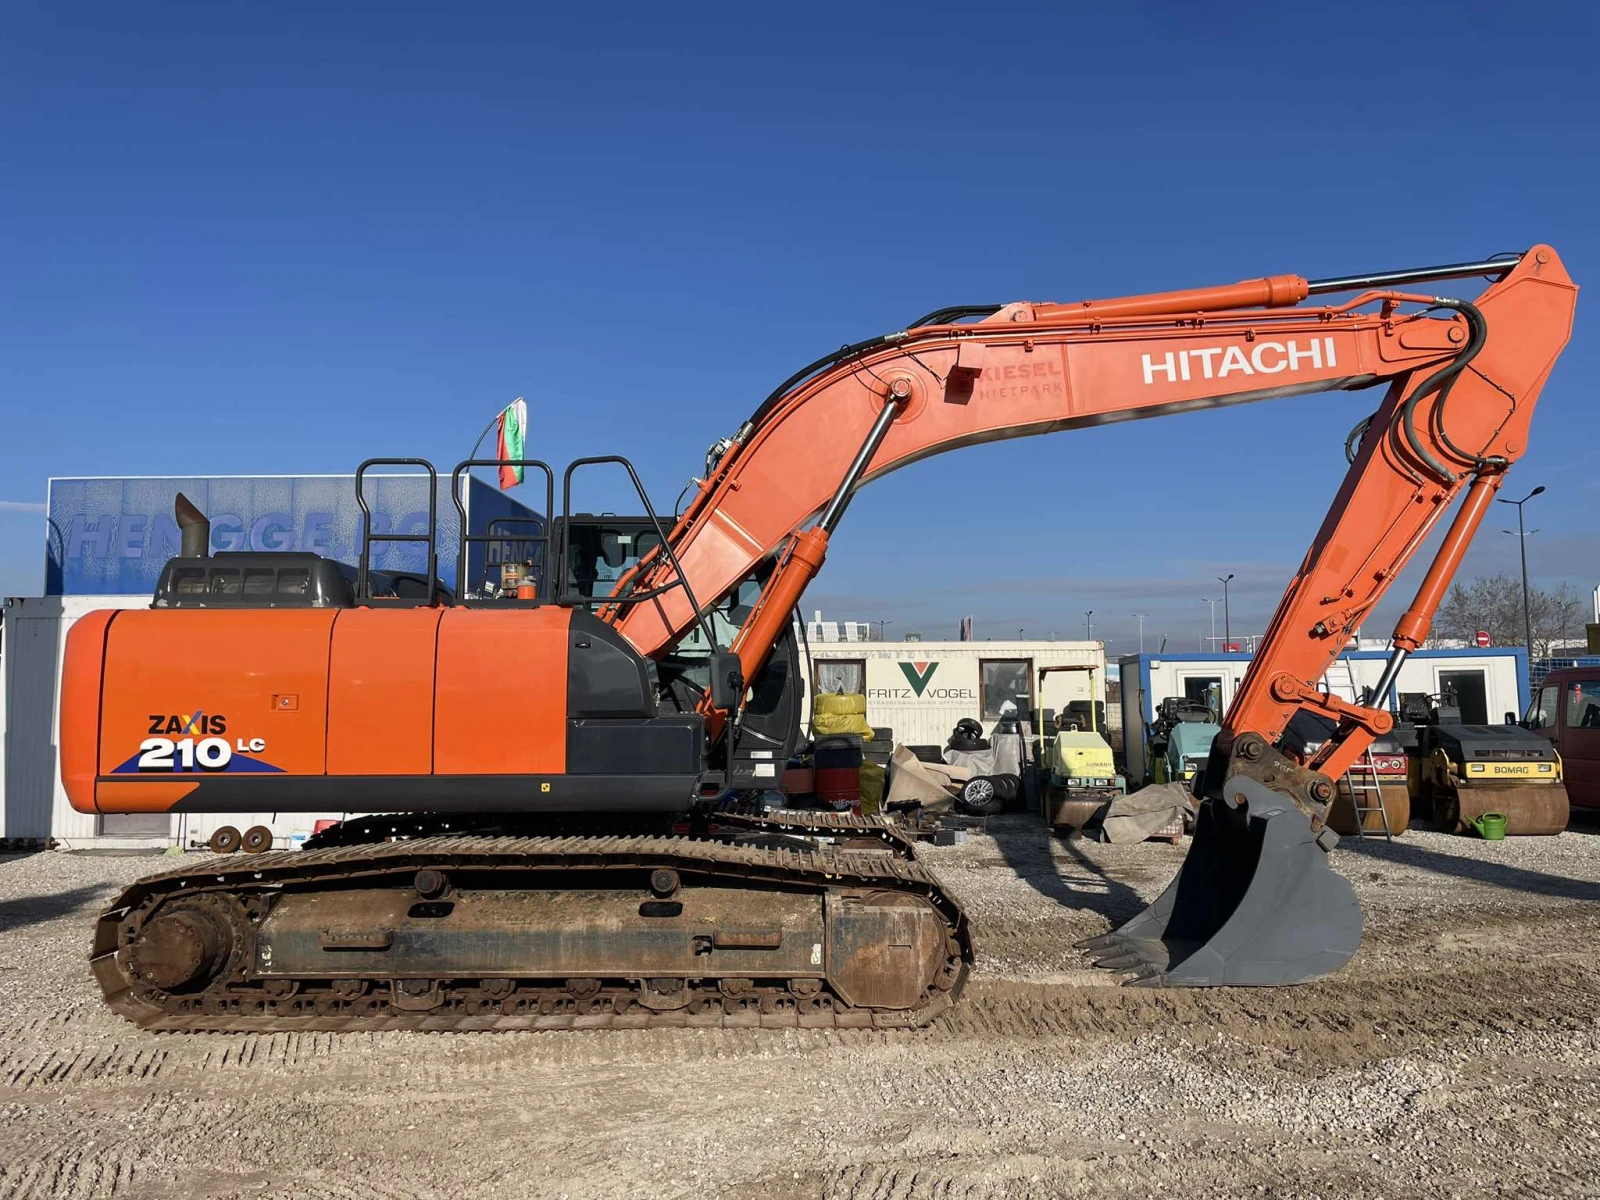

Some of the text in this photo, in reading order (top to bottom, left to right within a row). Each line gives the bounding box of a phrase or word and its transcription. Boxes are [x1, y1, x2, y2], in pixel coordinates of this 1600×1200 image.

[1141, 337, 1337, 384] HITACHI
[979, 361, 1061, 382] KIESEL
[980, 382, 1063, 400] MIETPARK
[868, 688, 977, 699] FRITZ VOGEL
[148, 709, 227, 735] ZAXIS
[138, 738, 266, 770] 210 LC
[1494, 766, 1529, 774] BOMAG
